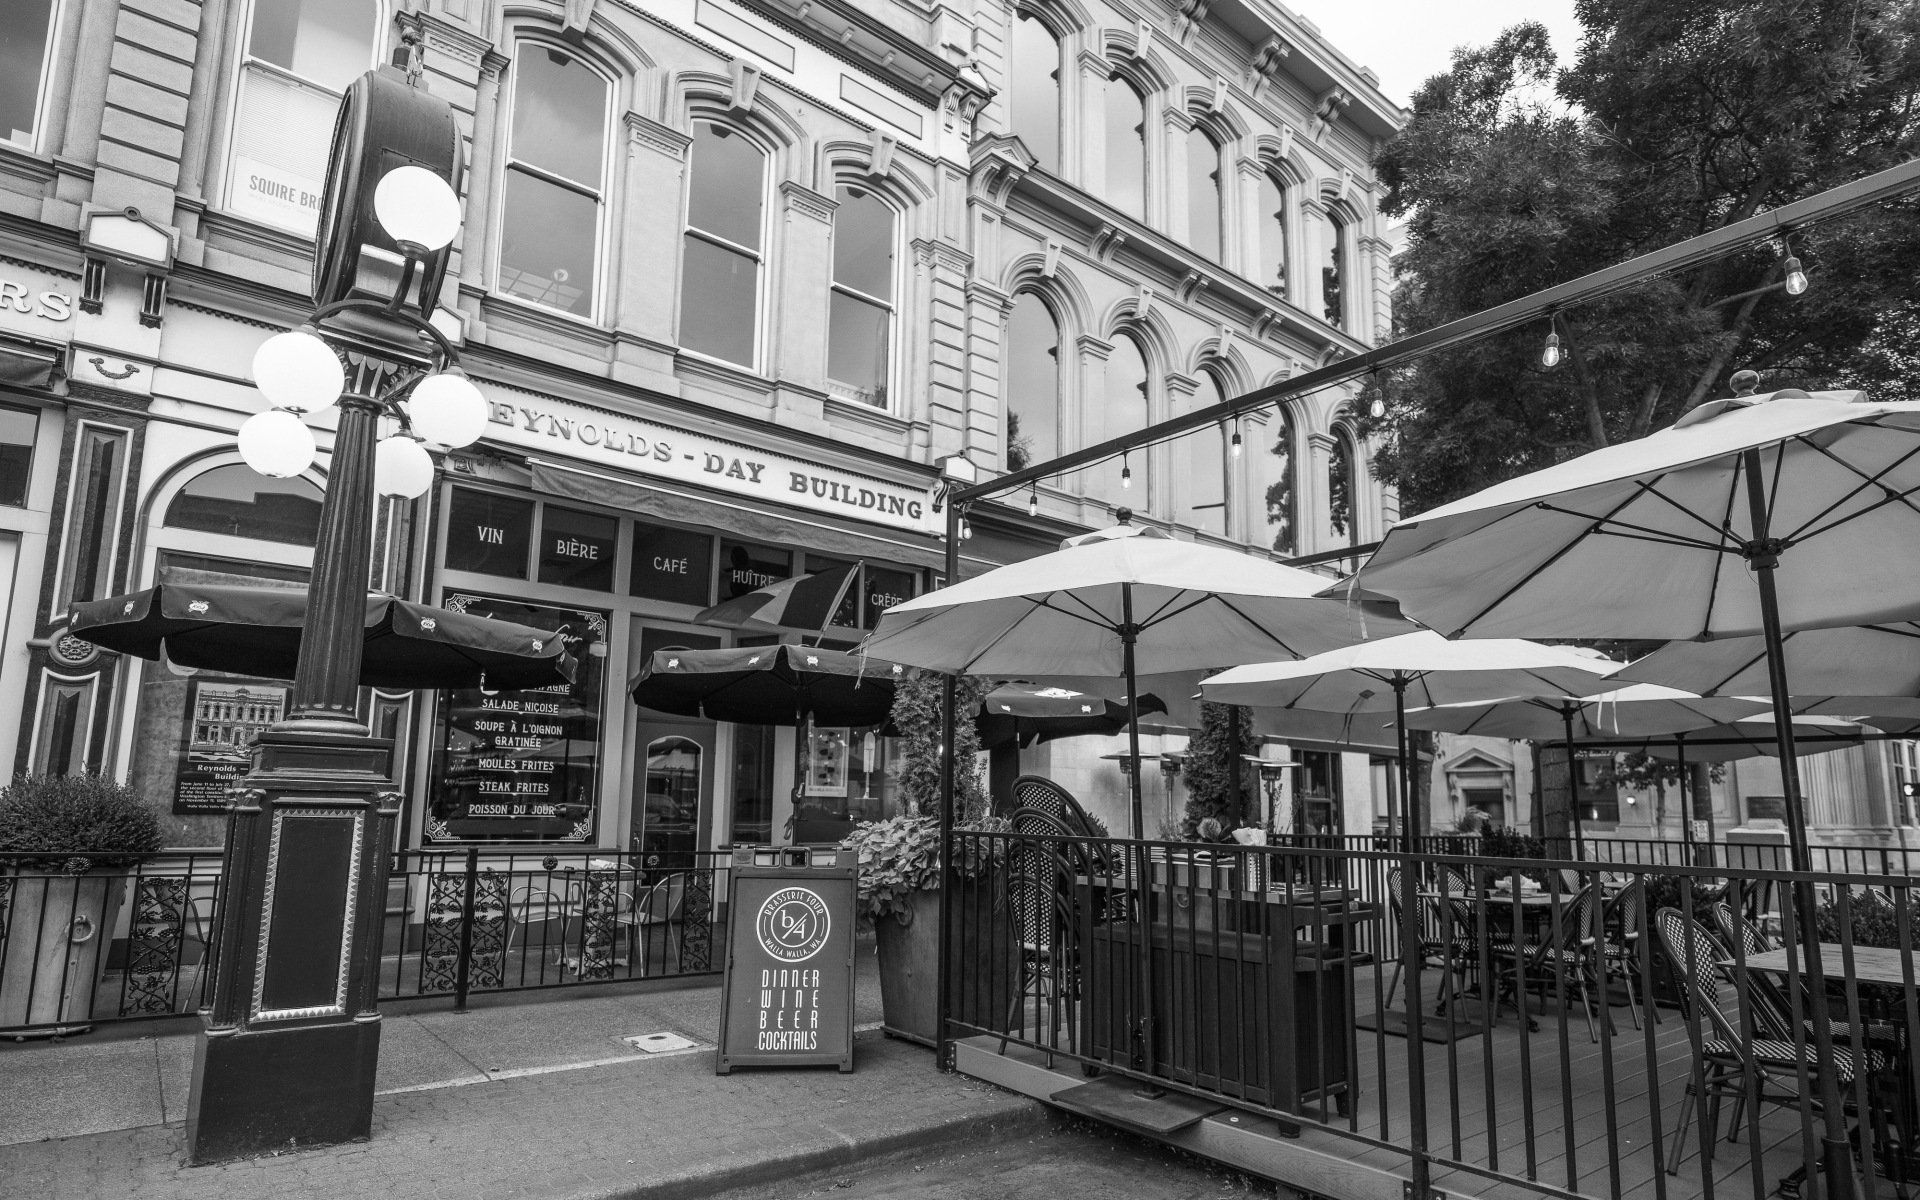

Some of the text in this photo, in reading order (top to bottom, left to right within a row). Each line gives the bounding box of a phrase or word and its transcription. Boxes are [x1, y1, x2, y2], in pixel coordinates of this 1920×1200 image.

[249, 174, 296, 203] SQUIRE
[488, 399, 672, 462] EYNOLDS
[703, 451, 766, 484] DAY
[789, 471, 923, 520] BUILDING
[477, 525, 504, 545] VIN
[556, 537, 599, 560] BIÈRE
[653, 556, 688, 574] CAFÉ
[481, 698, 559, 713] SALADE NIÇOISE
[474, 720, 563, 735] SOUPE À L'OIGNON
[494, 734, 541, 748] GRATINÉE
[197, 764, 237, 773] Reynolds
[478, 758, 554, 771] MOULES FRITES
[479, 781, 550, 793] STEAK FRITES
[468, 803, 555, 815] POISSON DU JOUR
[764, 891, 824, 916] BRASSERIE FOUR
[764, 938, 784, 956] WALLA
[809, 939, 821, 949] WA
[761, 969, 820, 988] DINNER
[761, 989, 819, 1008] WINE
[760, 1010, 818, 1029] BEER
[758, 1031, 817, 1051] COCKTAILS
